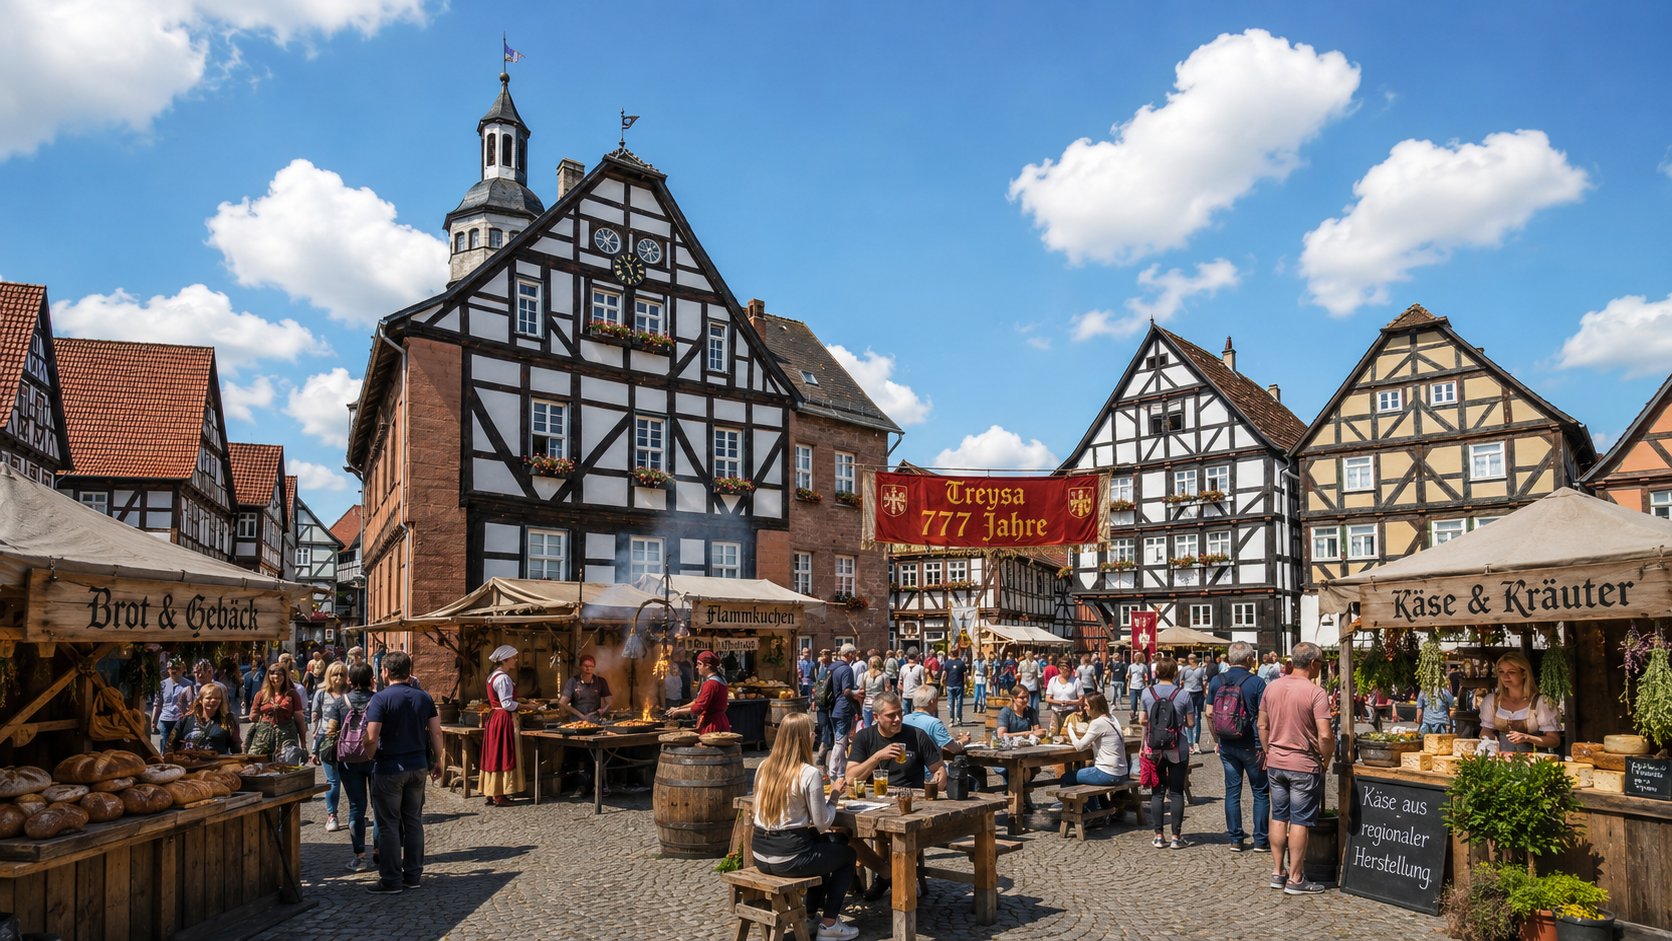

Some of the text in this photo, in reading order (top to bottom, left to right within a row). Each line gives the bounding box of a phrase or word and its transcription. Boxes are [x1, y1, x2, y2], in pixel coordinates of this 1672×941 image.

[945, 480, 1025, 511] Treysa
[921, 510, 1048, 542] 777 Jahre
[86, 586, 259, 638] Brot & Gebäck
[706, 605, 795, 627] Flammkuchen
[1392, 578, 1634, 623] Käse & Kräuter
[1362, 785, 1427, 816] Käse aus
[1361, 822, 1430, 848] regionaler
